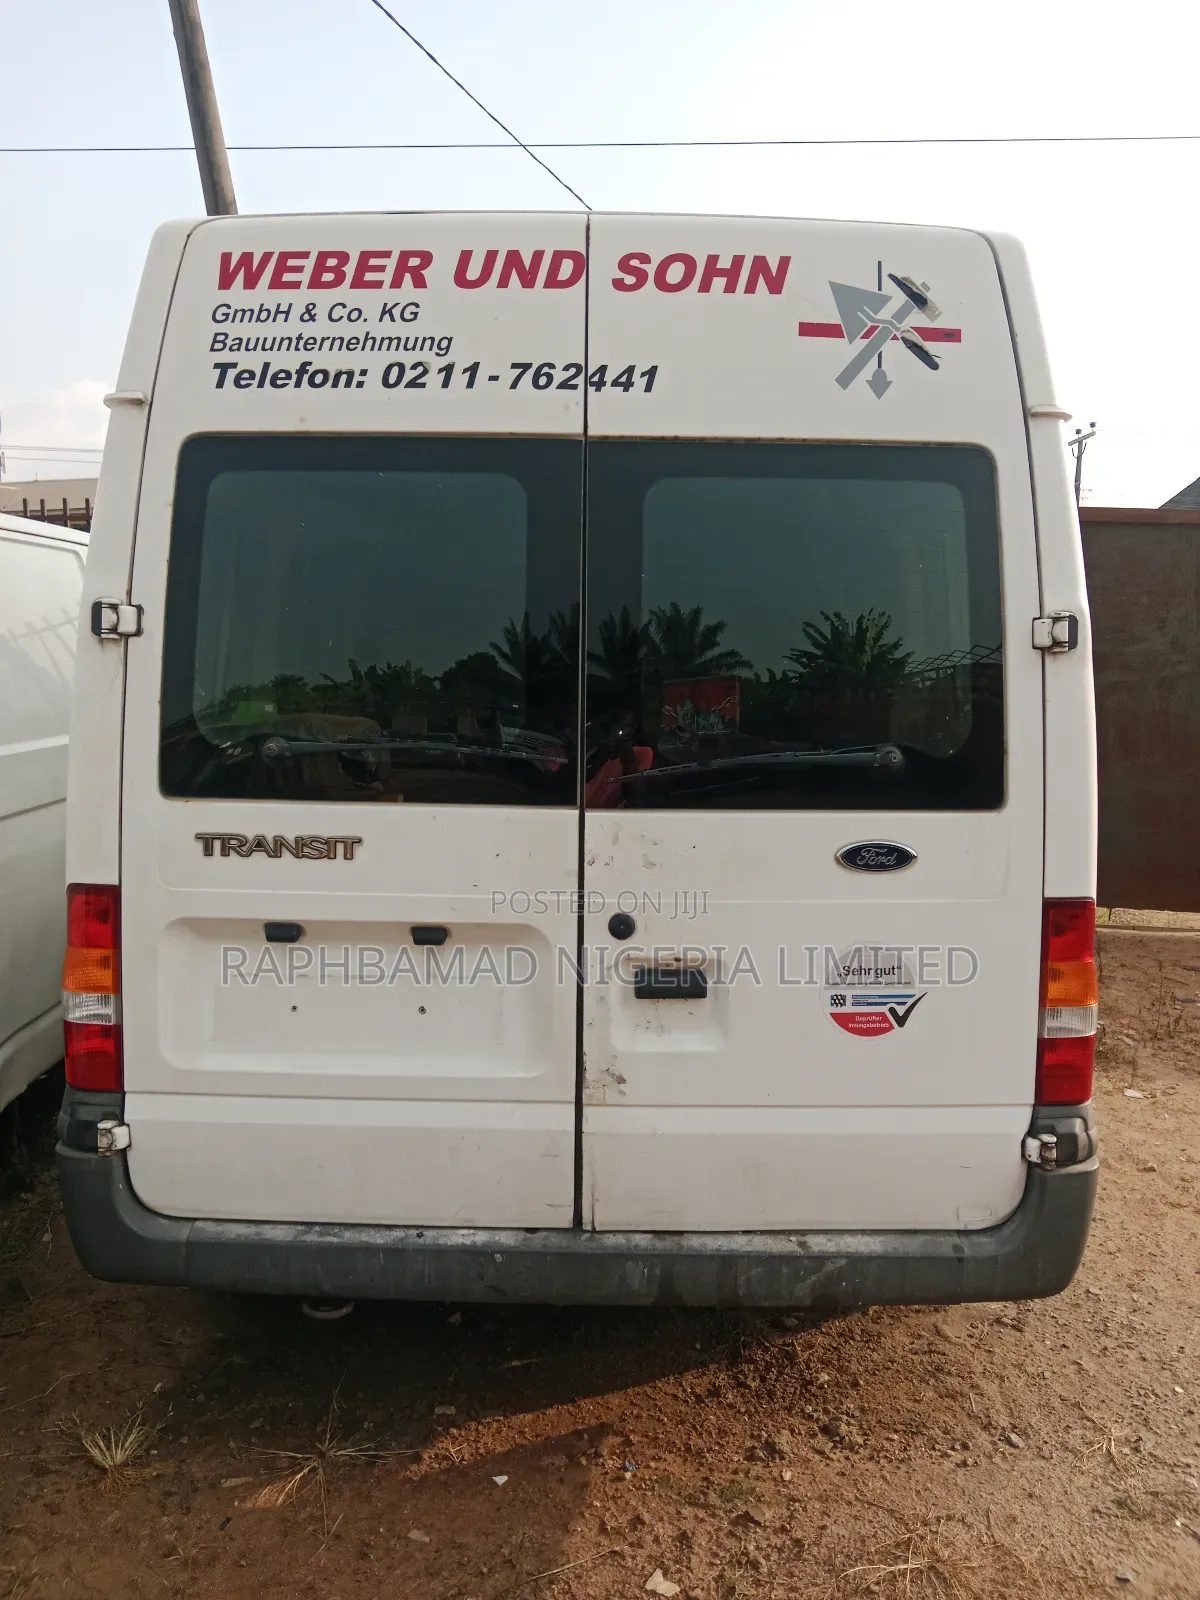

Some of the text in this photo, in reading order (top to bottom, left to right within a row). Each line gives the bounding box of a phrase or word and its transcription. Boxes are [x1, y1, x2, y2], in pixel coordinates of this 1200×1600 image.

[216, 249, 791, 295] WEBER UND SOHN
[211, 302, 420, 324] GmbH & Co. KG
[209, 332, 453, 357] Bauunternehmung
[212, 362, 368, 389] Telefon:
[195, 832, 363, 861] TRANSIT
[856, 847, 898, 866] Ford
